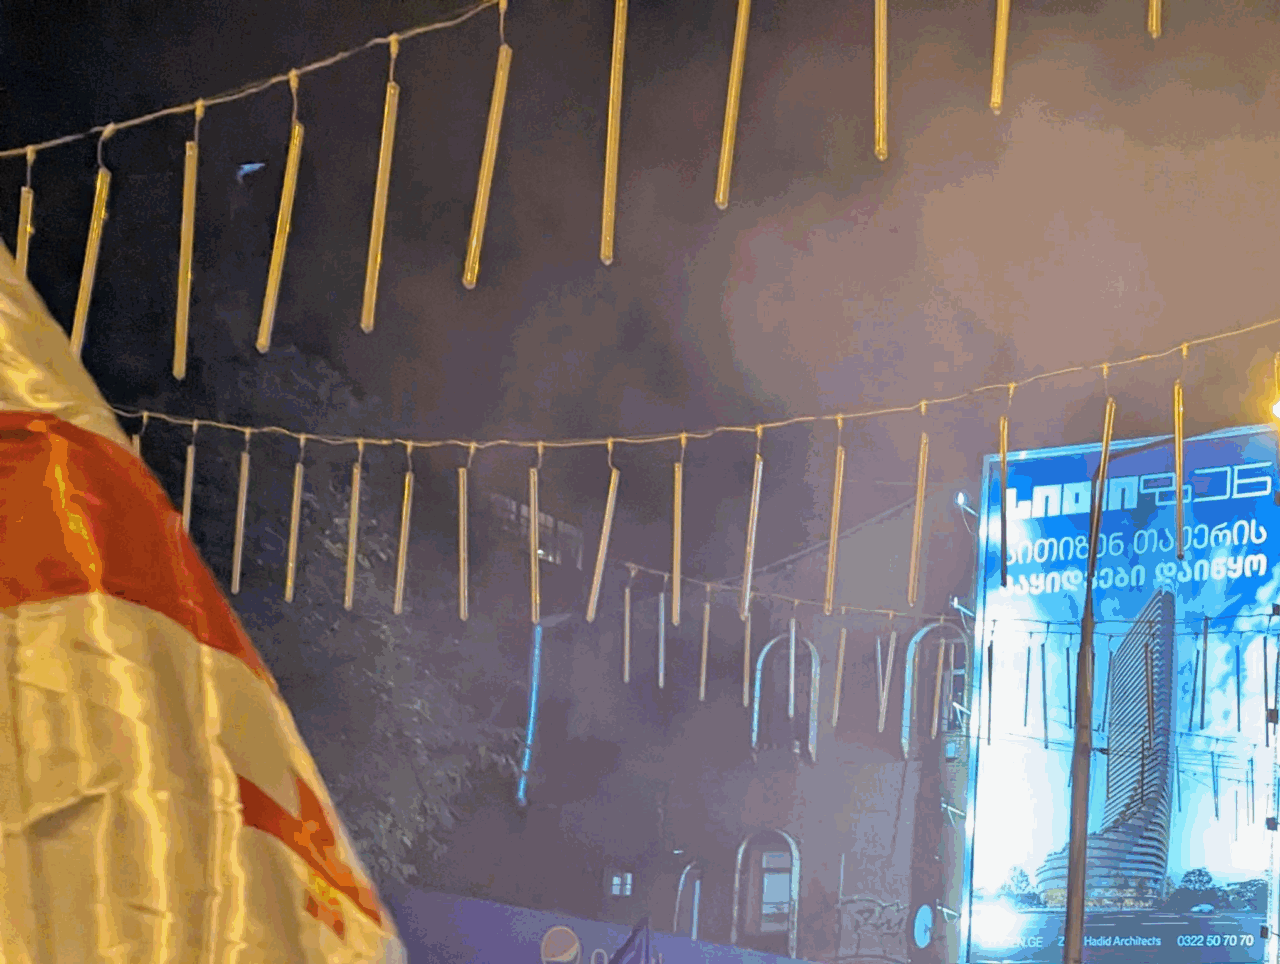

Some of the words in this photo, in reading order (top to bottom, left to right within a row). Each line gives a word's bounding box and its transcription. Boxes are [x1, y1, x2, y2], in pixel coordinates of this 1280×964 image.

[1154, 553, 1268, 583] დაიწყო
[1083, 935, 1112, 947] Hadid
[1112, 935, 1162, 947] Architects
[1176, 935, 1204, 947] 0322
[1206, 934, 1221, 947] 50
[1223, 934, 1238, 946] 70
[1239, 934, 1254, 946] 70
